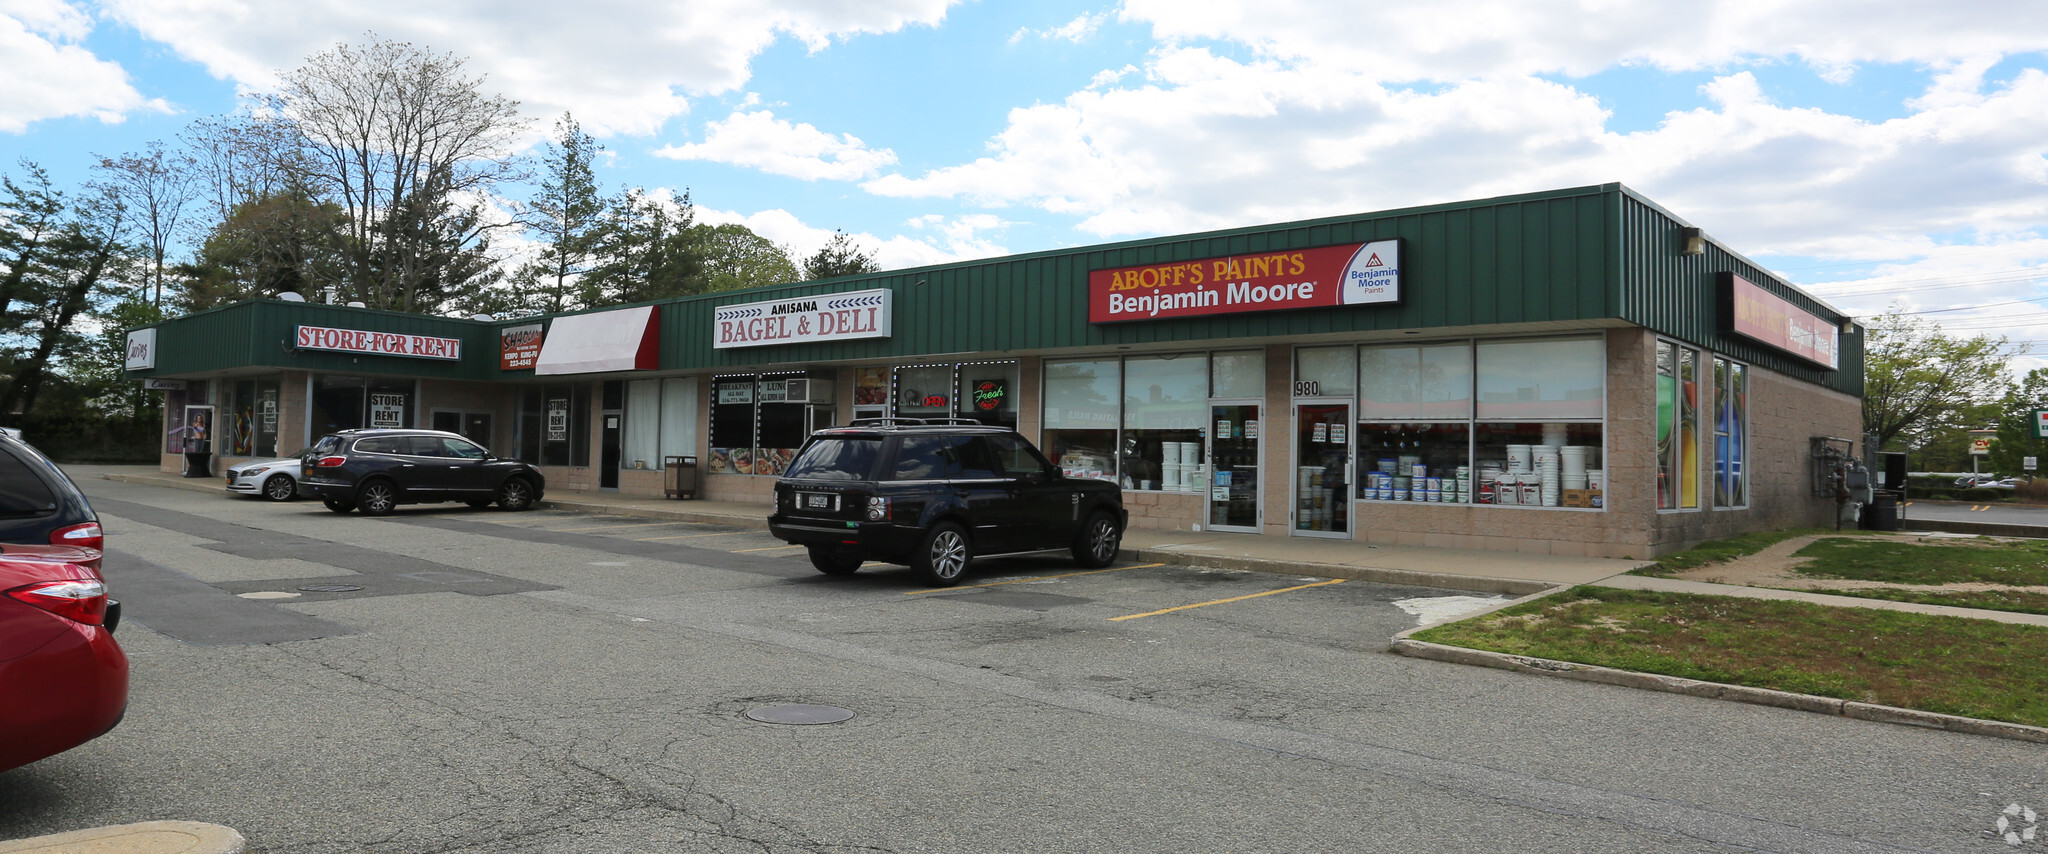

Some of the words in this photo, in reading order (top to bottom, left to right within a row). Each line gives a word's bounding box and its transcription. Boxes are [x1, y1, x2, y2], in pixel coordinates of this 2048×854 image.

[1109, 263, 1204, 291] ABOFF'S
[1213, 253, 1305, 281] PAINTS
[1351, 267, 1398, 280] Benjamin
[1358, 278, 1391, 288] Moore
[1109, 285, 1218, 316] Benjamin
[1226, 281, 1314, 304] Moore
[771, 301, 818, 315] AMISANA
[720, 316, 792, 343] BAGEL
[798, 315, 811, 335] &
[818, 308, 877, 335] DELI
[126, 338, 147, 360] Curves
[298, 327, 367, 350] STORE
[412, 336, 459, 358] RENT
[974, 386, 1003, 402] Fresh
[1296, 381, 1318, 396] 980
[372, 395, 403, 406] STORE
[550, 400, 566, 410] STORE
[922, 396, 946, 406] OPEN
[376, 411, 399, 421] RENT
[551, 416, 564, 425] RENT
